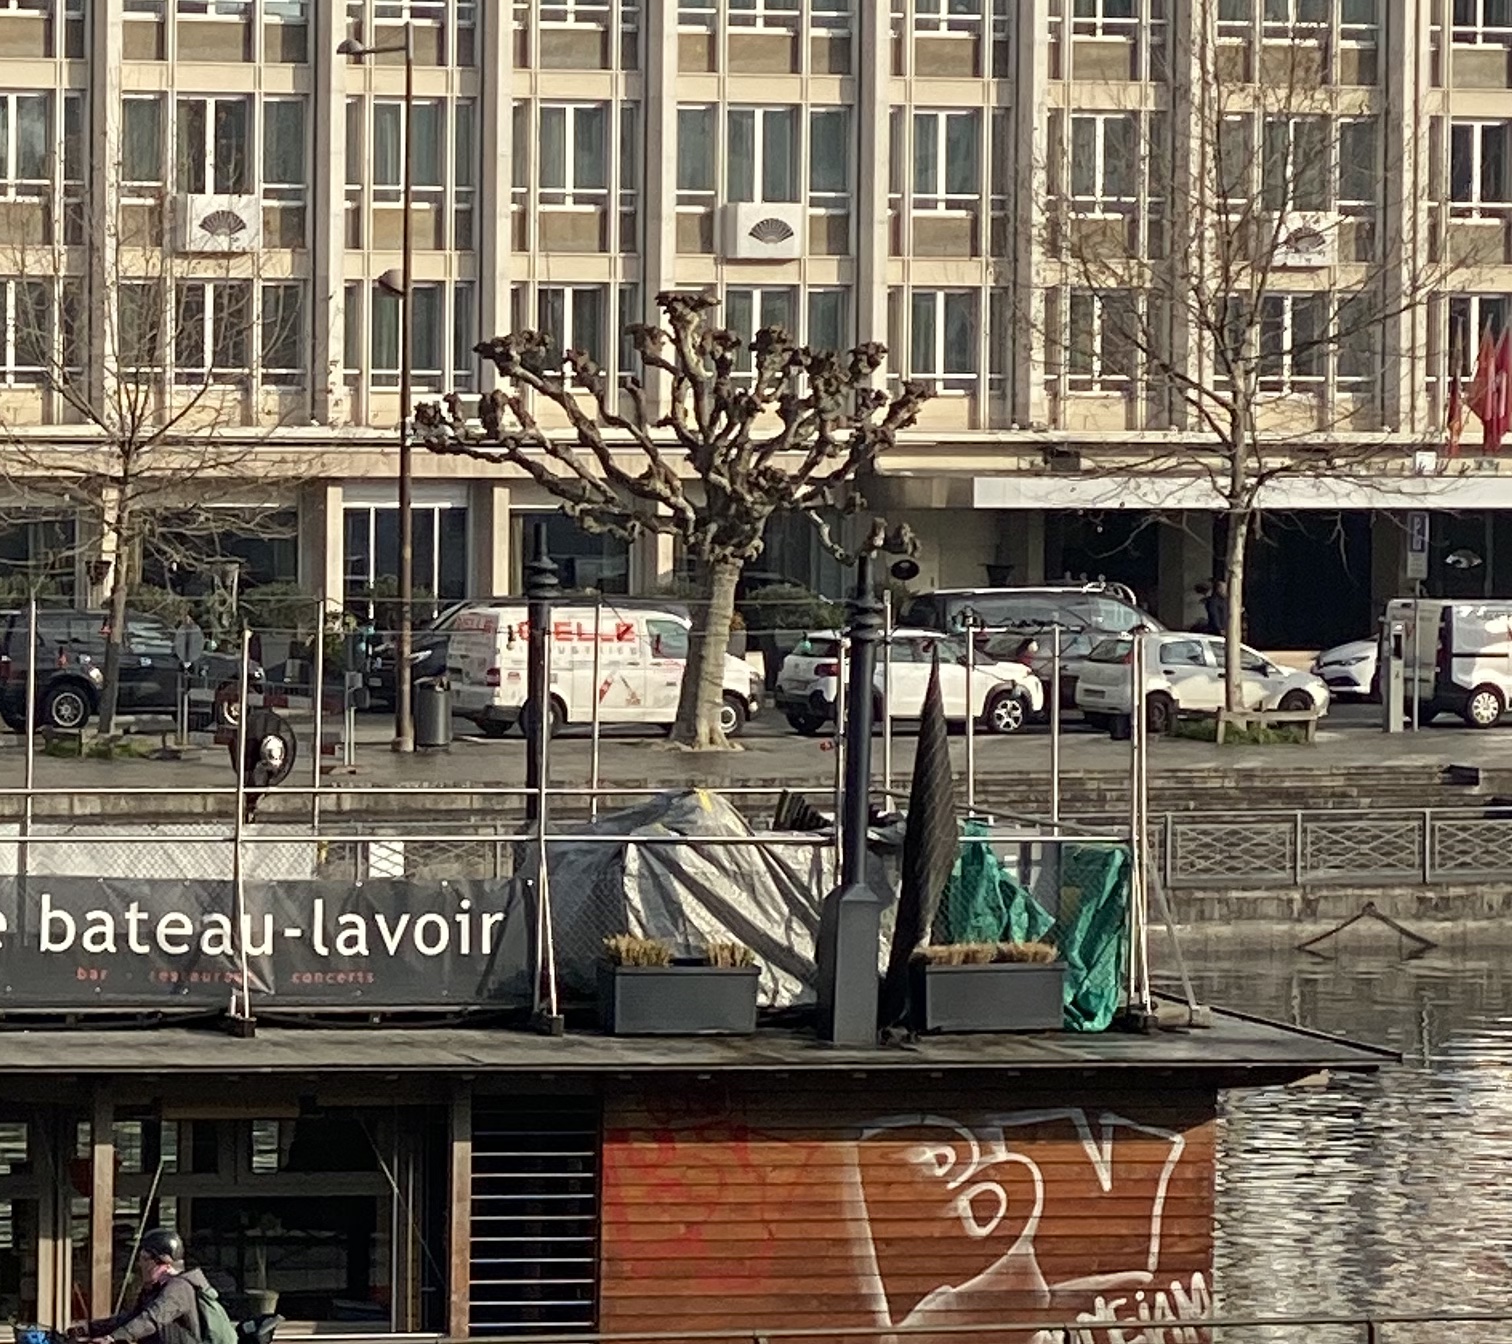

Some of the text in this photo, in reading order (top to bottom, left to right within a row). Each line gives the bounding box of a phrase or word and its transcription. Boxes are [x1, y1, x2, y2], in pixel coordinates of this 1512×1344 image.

[40, 893, 505, 957] bateau-lavoir
[76, 966, 108, 982] bar
[291, 968, 374, 984] concerts
